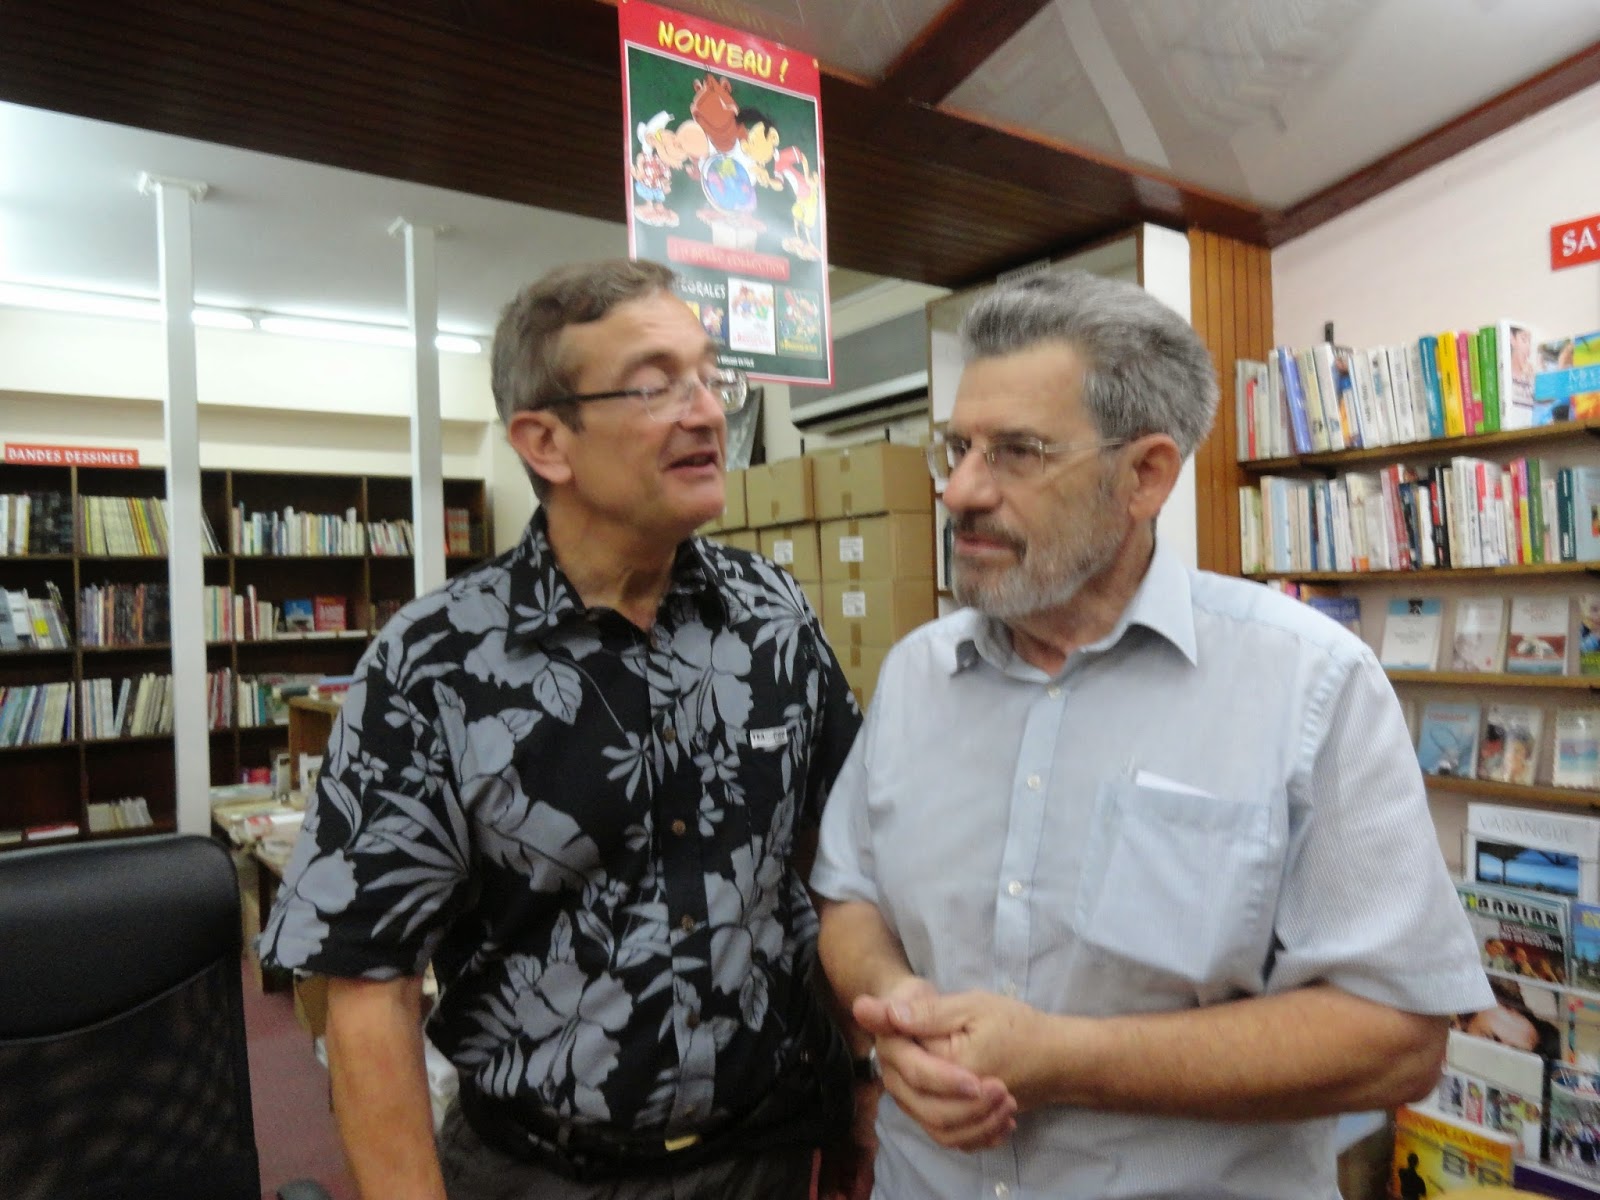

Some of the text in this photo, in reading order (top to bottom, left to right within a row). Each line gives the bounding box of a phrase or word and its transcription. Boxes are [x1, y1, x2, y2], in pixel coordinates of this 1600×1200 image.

[658, 20, 789, 84] NOUVEAU !
[1562, 222, 1600, 257] SA
[8, 446, 62, 463] BANDES
